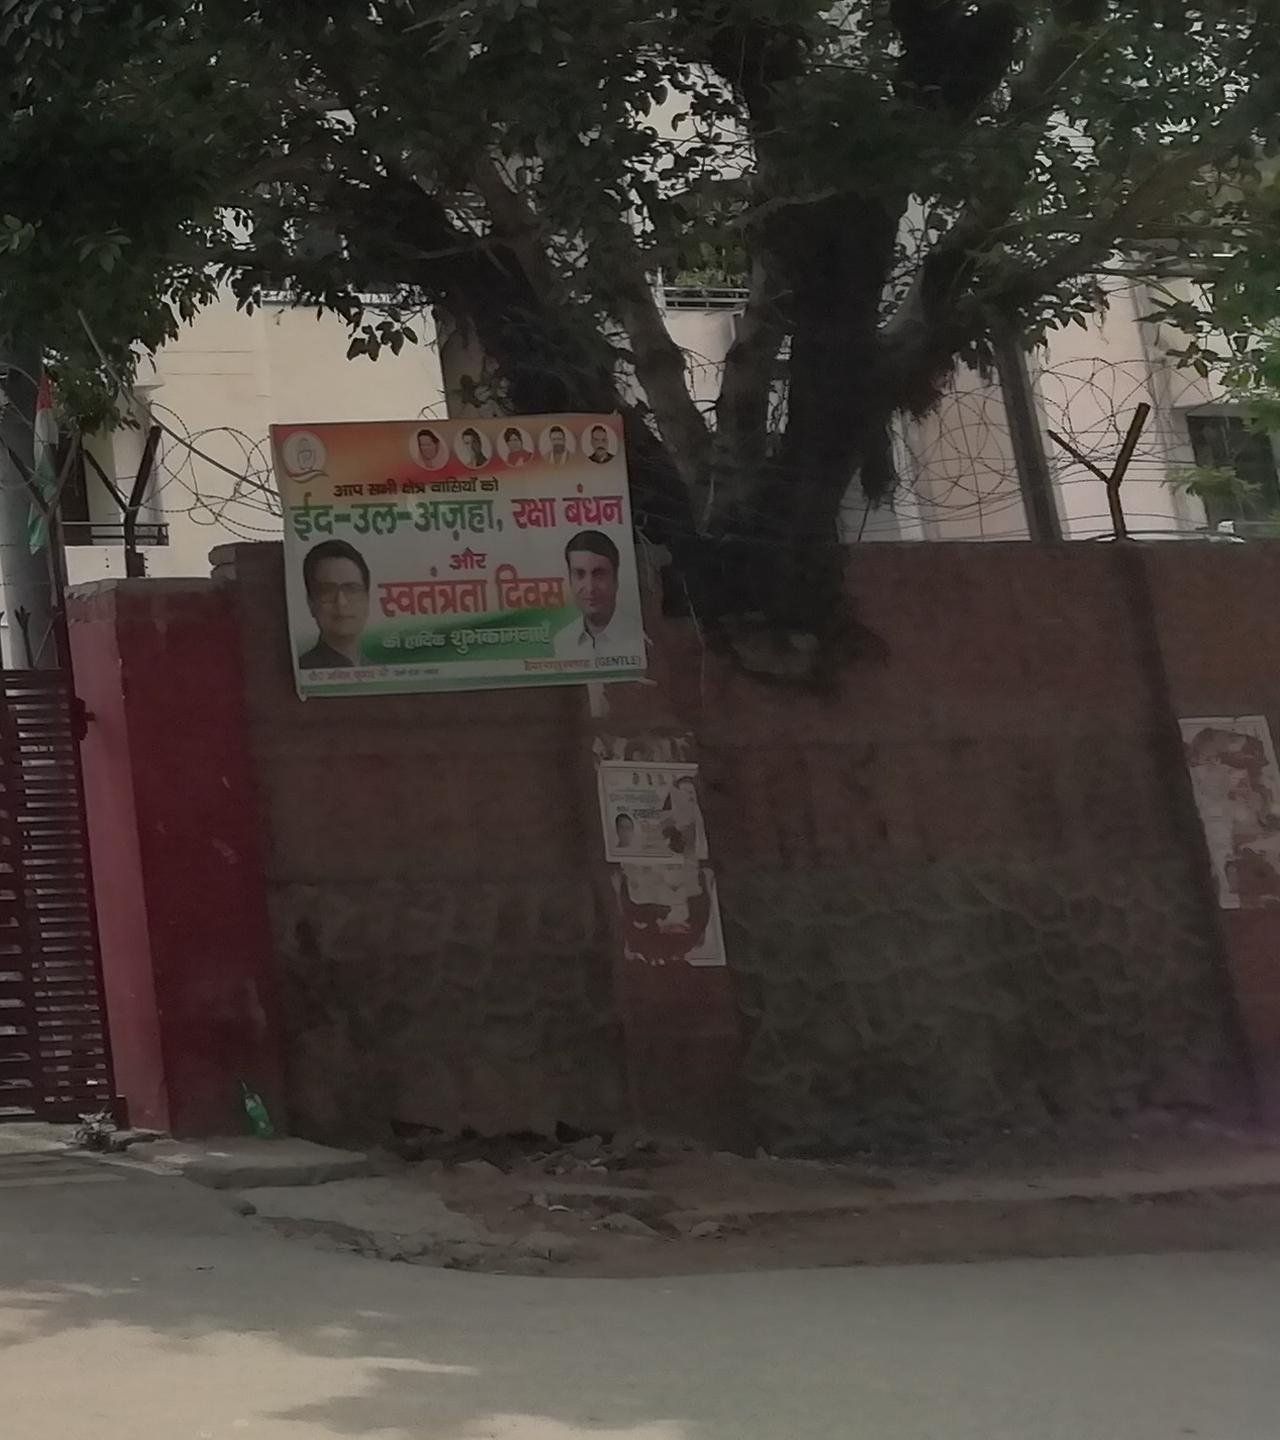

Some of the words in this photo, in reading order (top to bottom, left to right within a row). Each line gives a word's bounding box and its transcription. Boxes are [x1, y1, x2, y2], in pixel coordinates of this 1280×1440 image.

[510, 497, 558, 530] रक्षा
[561, 482, 625, 527] बंधन
[449, 547, 488, 571] और
[377, 565, 488, 619] स्वतंत्रता
[495, 563, 566, 610] दिवस
